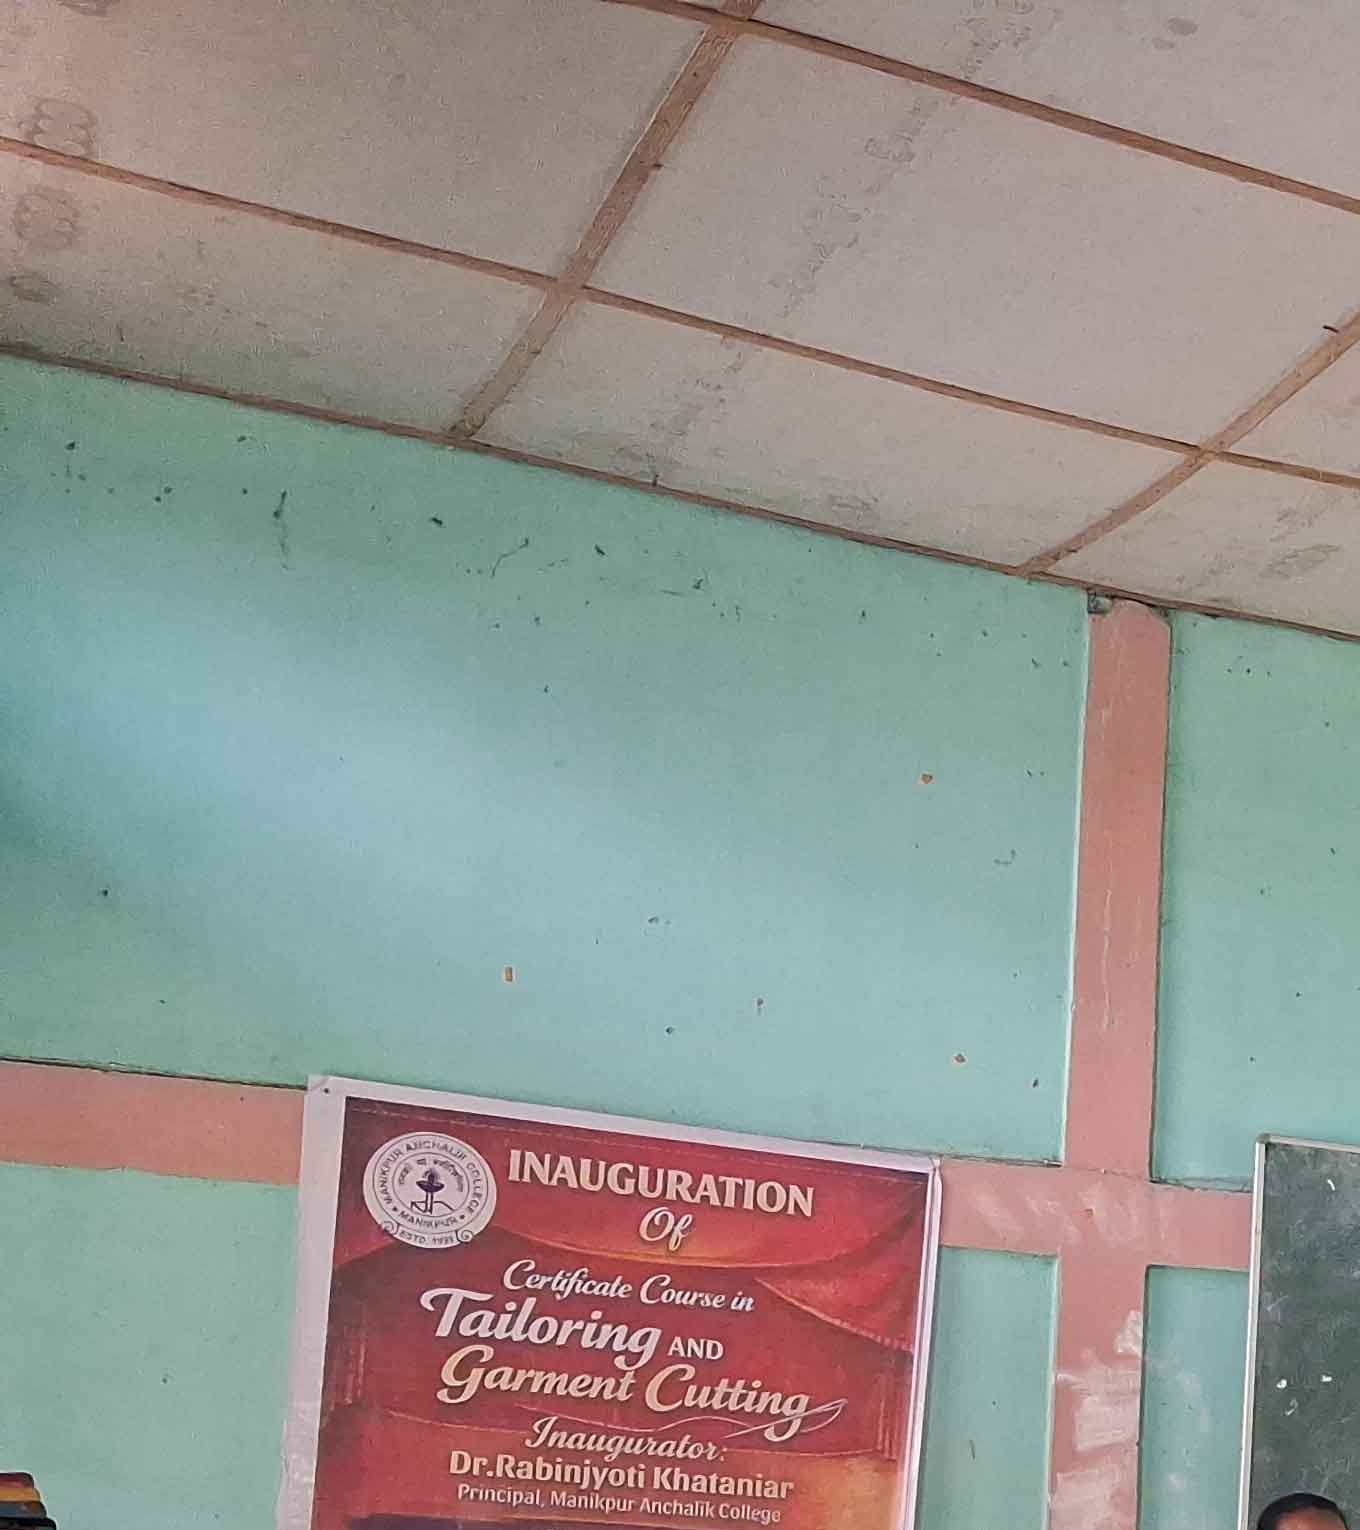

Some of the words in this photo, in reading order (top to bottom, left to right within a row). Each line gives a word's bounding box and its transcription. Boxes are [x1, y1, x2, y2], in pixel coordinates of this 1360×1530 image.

[507, 1149, 814, 1217] INAUGURATION
[639, 1206, 693, 1251] Of
[503, 1259, 633, 1300] Certificate
[639, 1275, 725, 1309] Course
[729, 1291, 754, 1313] in
[419, 1287, 663, 1371] Tailoring
[667, 1336, 724, 1361] AND
[436, 1345, 636, 1404] Garment
[645, 1364, 811, 1442] Cutting
[525, 1416, 727, 1462] Inaugurator:
[449, 1450, 646, 1490] Dr.Rabinjyoti
[652, 1466, 795, 1499] Khataniar
[457, 1484, 544, 1508] Principal,
[550, 1490, 636, 1514] Manikpur
[640, 1498, 715, 1519] Anchalik
[718, 1503, 782, 1524] College
